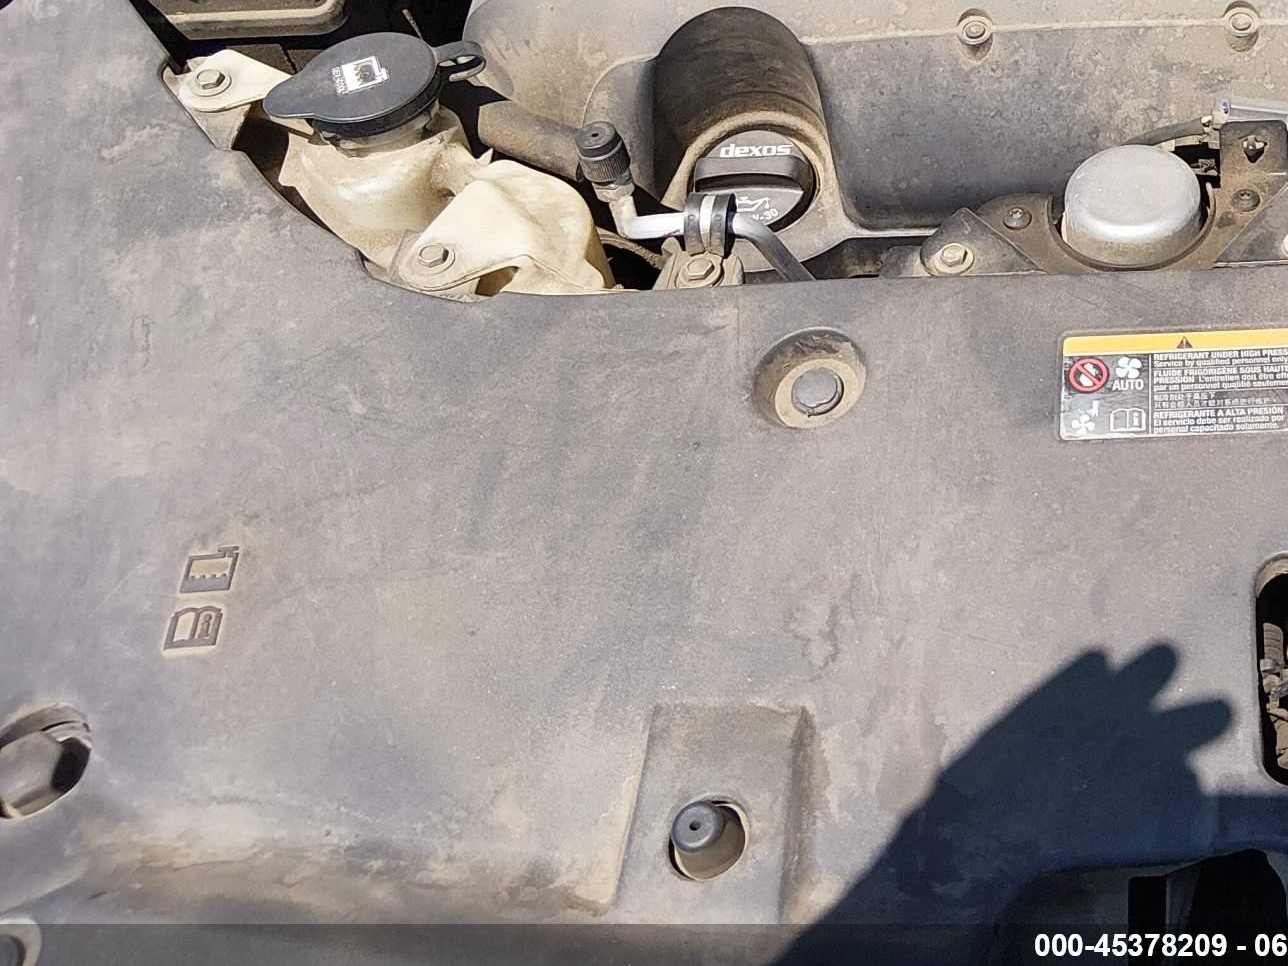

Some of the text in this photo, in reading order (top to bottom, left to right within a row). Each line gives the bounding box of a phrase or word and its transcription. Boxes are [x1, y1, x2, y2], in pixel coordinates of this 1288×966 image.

[719, 143, 795, 158] dexos
[1153, 352, 1209, 361] REFRIGERANT
[1211, 351, 1239, 359] UNDER
[1240, 349, 1261, 357] HIGH
[1154, 360, 1183, 368] Service
[1185, 359, 1195, 368] by
[1197, 358, 1231, 367] qualified
[1232, 355, 1270, 365] personnel
[1154, 369, 1183, 377] FLUIDE
[1184, 367, 1238, 376] FRIGORIGÈNE
[1240, 366, 1261, 374] SOUS
[1241, 373, 1257, 381] doit
[1112, 379, 1144, 391] AUTO
[1154, 384, 1167, 392] par
[1181, 382, 1220, 391] personnel
[1221, 380, 1251, 389] qualifié
[1153, 406, 1284, 419] REFRIGERANTE A ALTA PRESIÓN
[1162, 417, 1195, 426] servicio
[1196, 417, 1217, 425] debe
[1218, 416, 1232, 424] ser
[1233, 415, 1269, 423] realizado
[1271, 414, 1285, 422] por
[1154, 422, 1279, 433] personal capacitado solamente.
